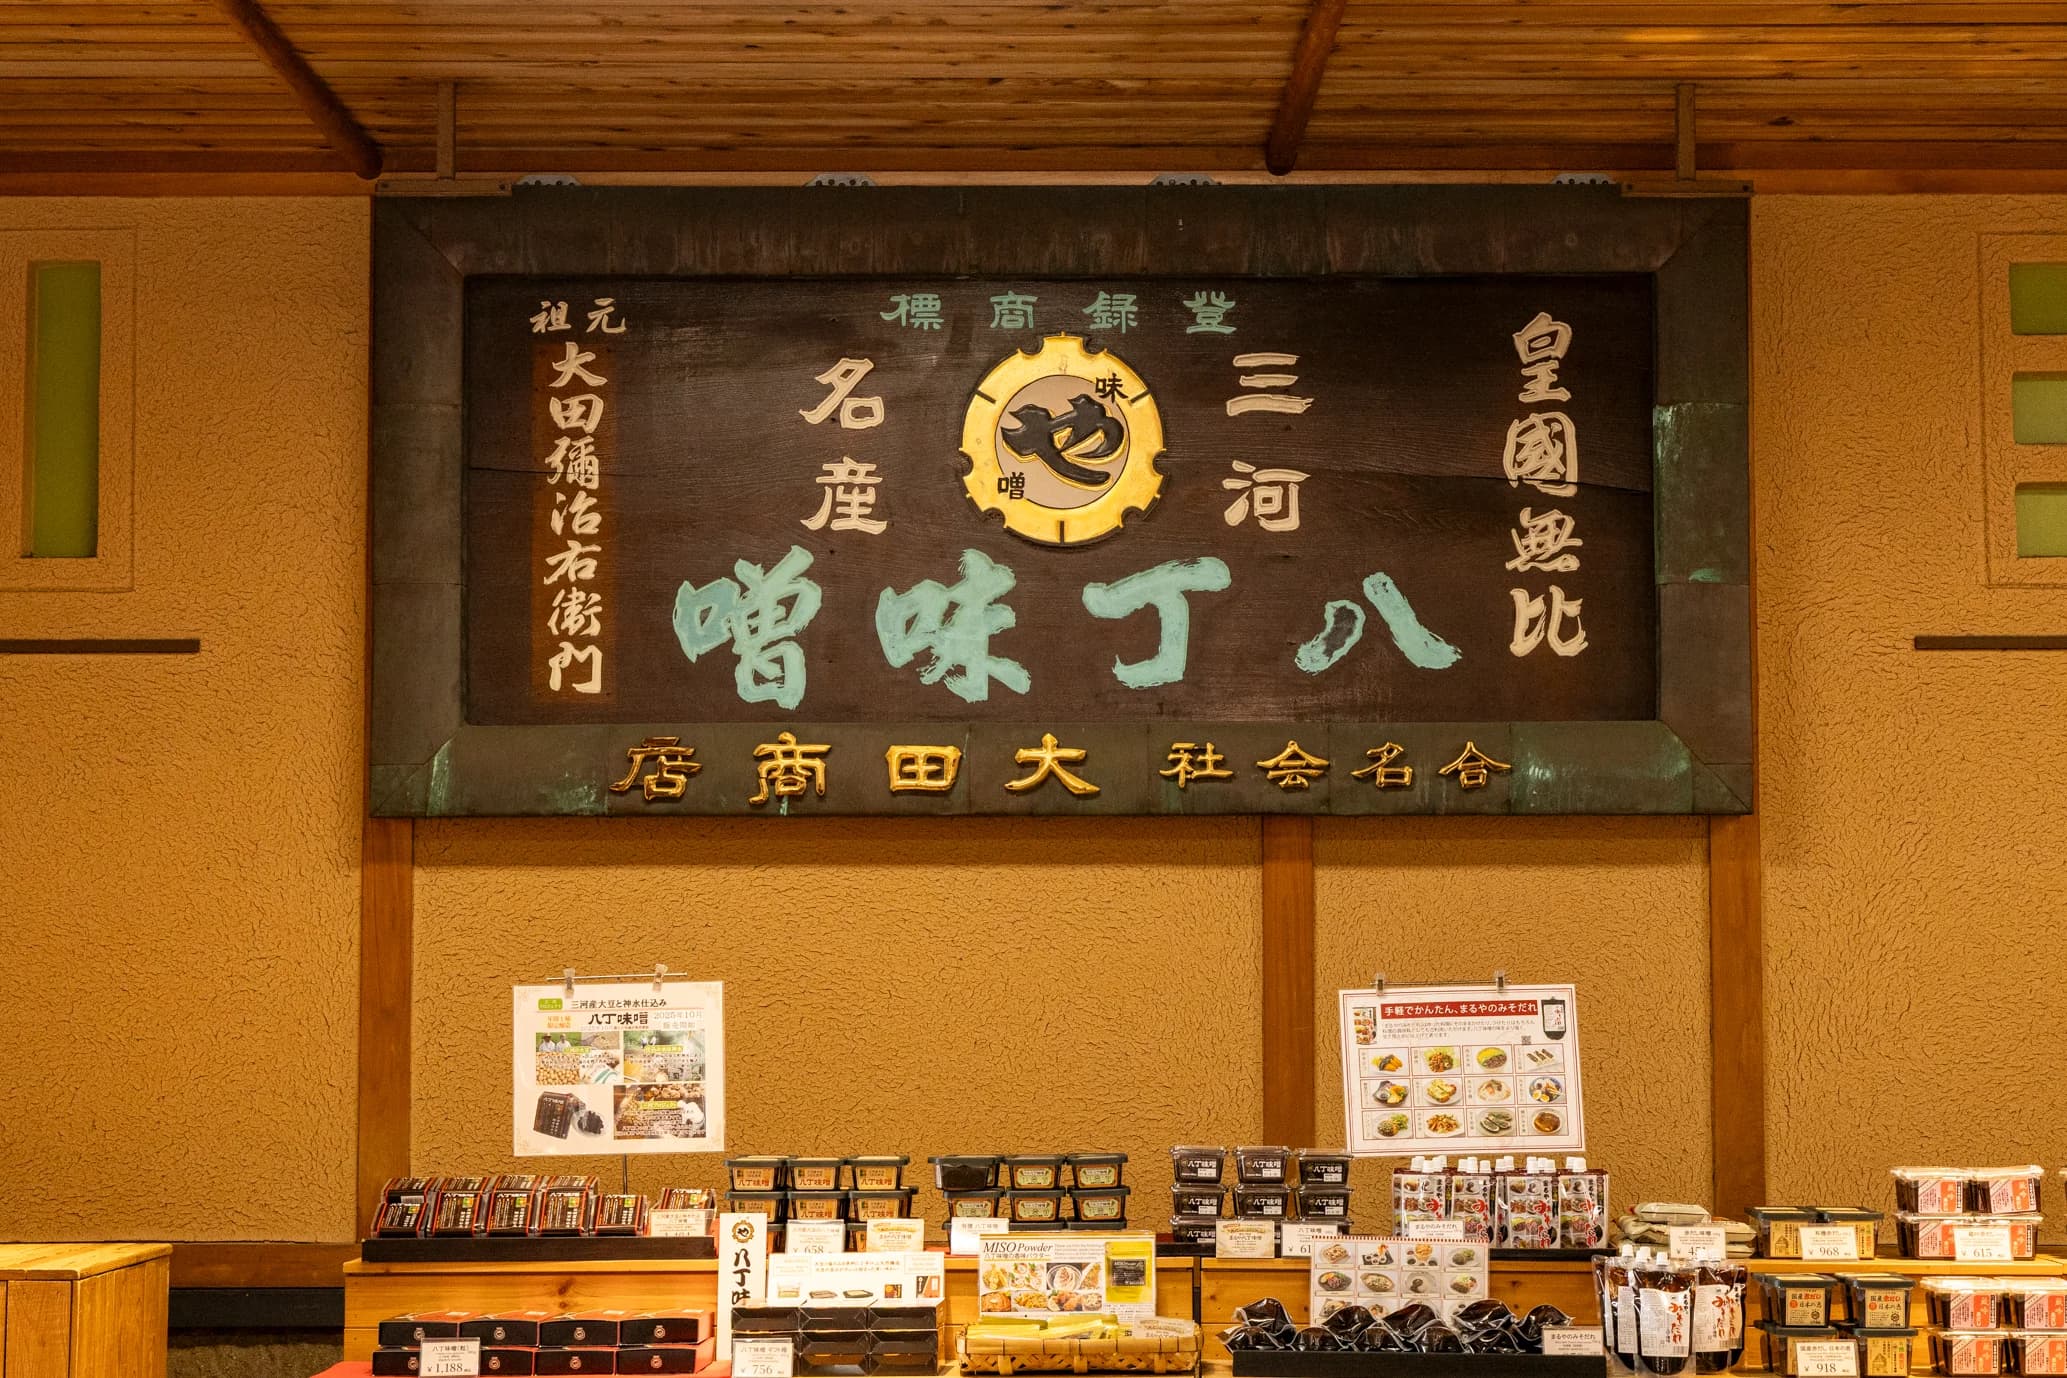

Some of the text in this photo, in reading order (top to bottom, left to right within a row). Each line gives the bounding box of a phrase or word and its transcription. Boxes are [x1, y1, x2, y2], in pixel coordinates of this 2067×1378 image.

[799, 357, 887, 535] 名産
[1223, 352, 1314, 532] 三河
[1503, 312, 1588, 657] 皇國無比
[1384, 1002, 1537, 1016] 手軽でかんたん、まるやのみそだれ
[588, 1012, 649, 1025] 八丁味噌
[984, 1242, 1017, 1253] MISO
[1017, 1242, 1054, 1253] Powder
[1819, 1246, 1840, 1256] 968
[1973, 1248, 1993, 1257] 615
[731, 1248, 752, 1305] 八丁味
[436, 1362, 463, 1374] 1,188
[752, 1364, 773, 1375] 756
[1817, 1362, 1837, 1373] 918
